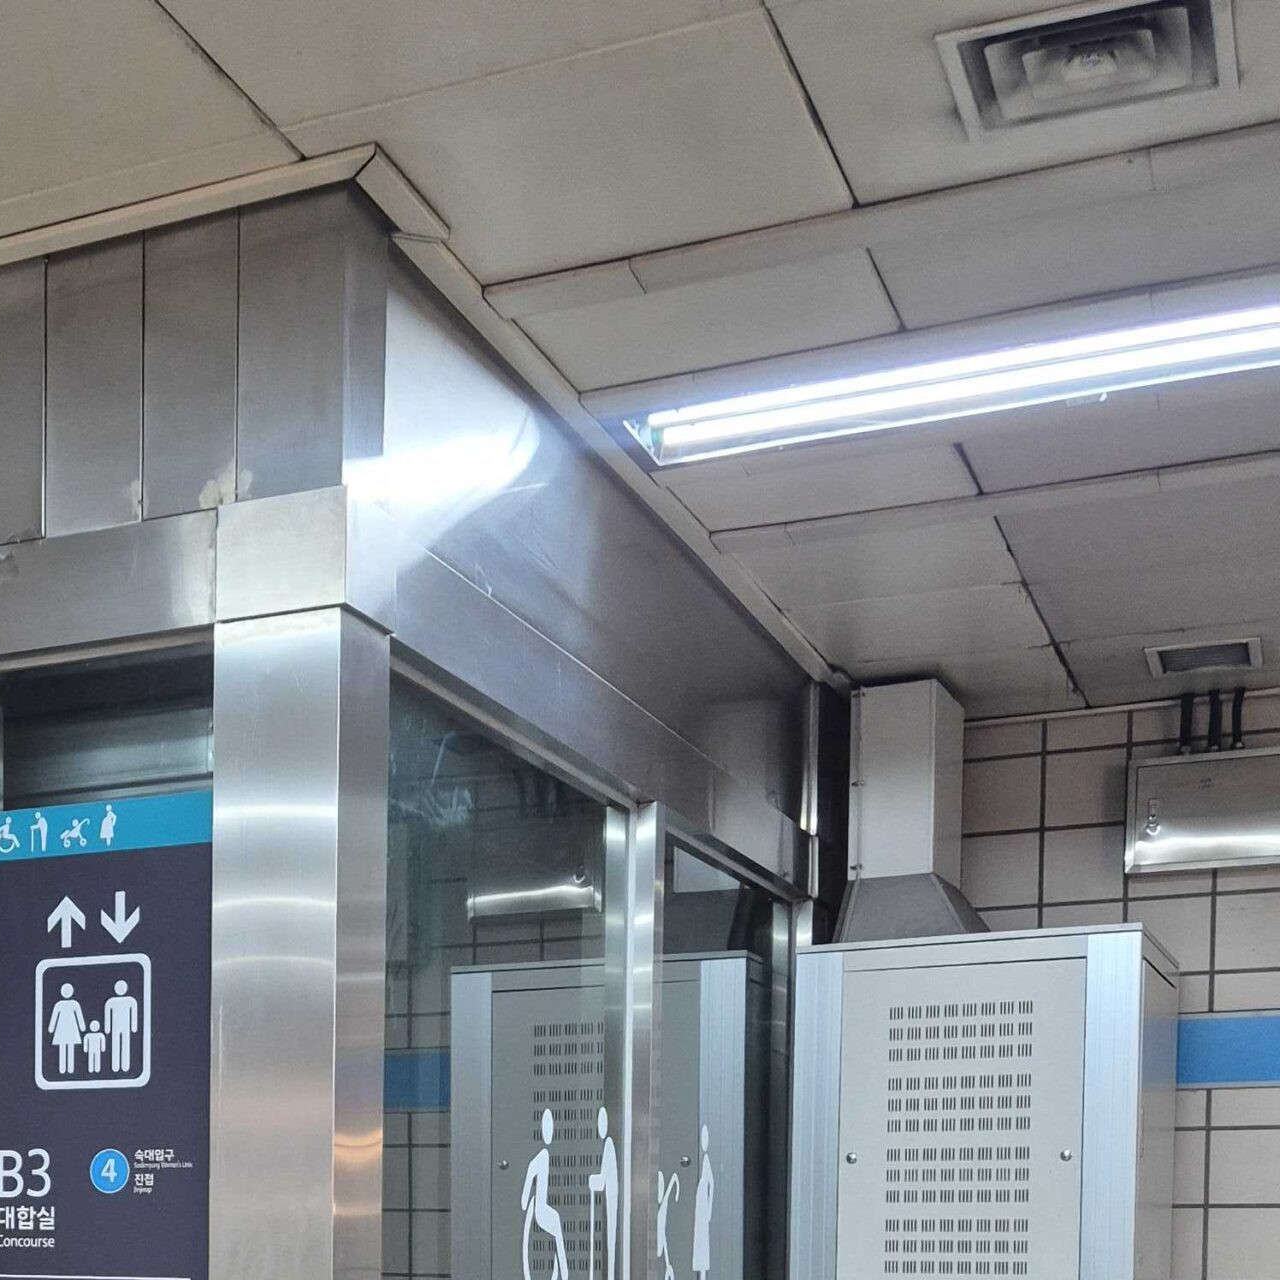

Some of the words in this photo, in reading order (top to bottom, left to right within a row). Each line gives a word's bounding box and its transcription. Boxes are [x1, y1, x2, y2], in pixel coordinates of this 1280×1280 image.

[134, 1149, 175, 1162] 숙대입구
[100, 1158, 118, 1184] 4
[134, 1173, 154, 1186] 진접
